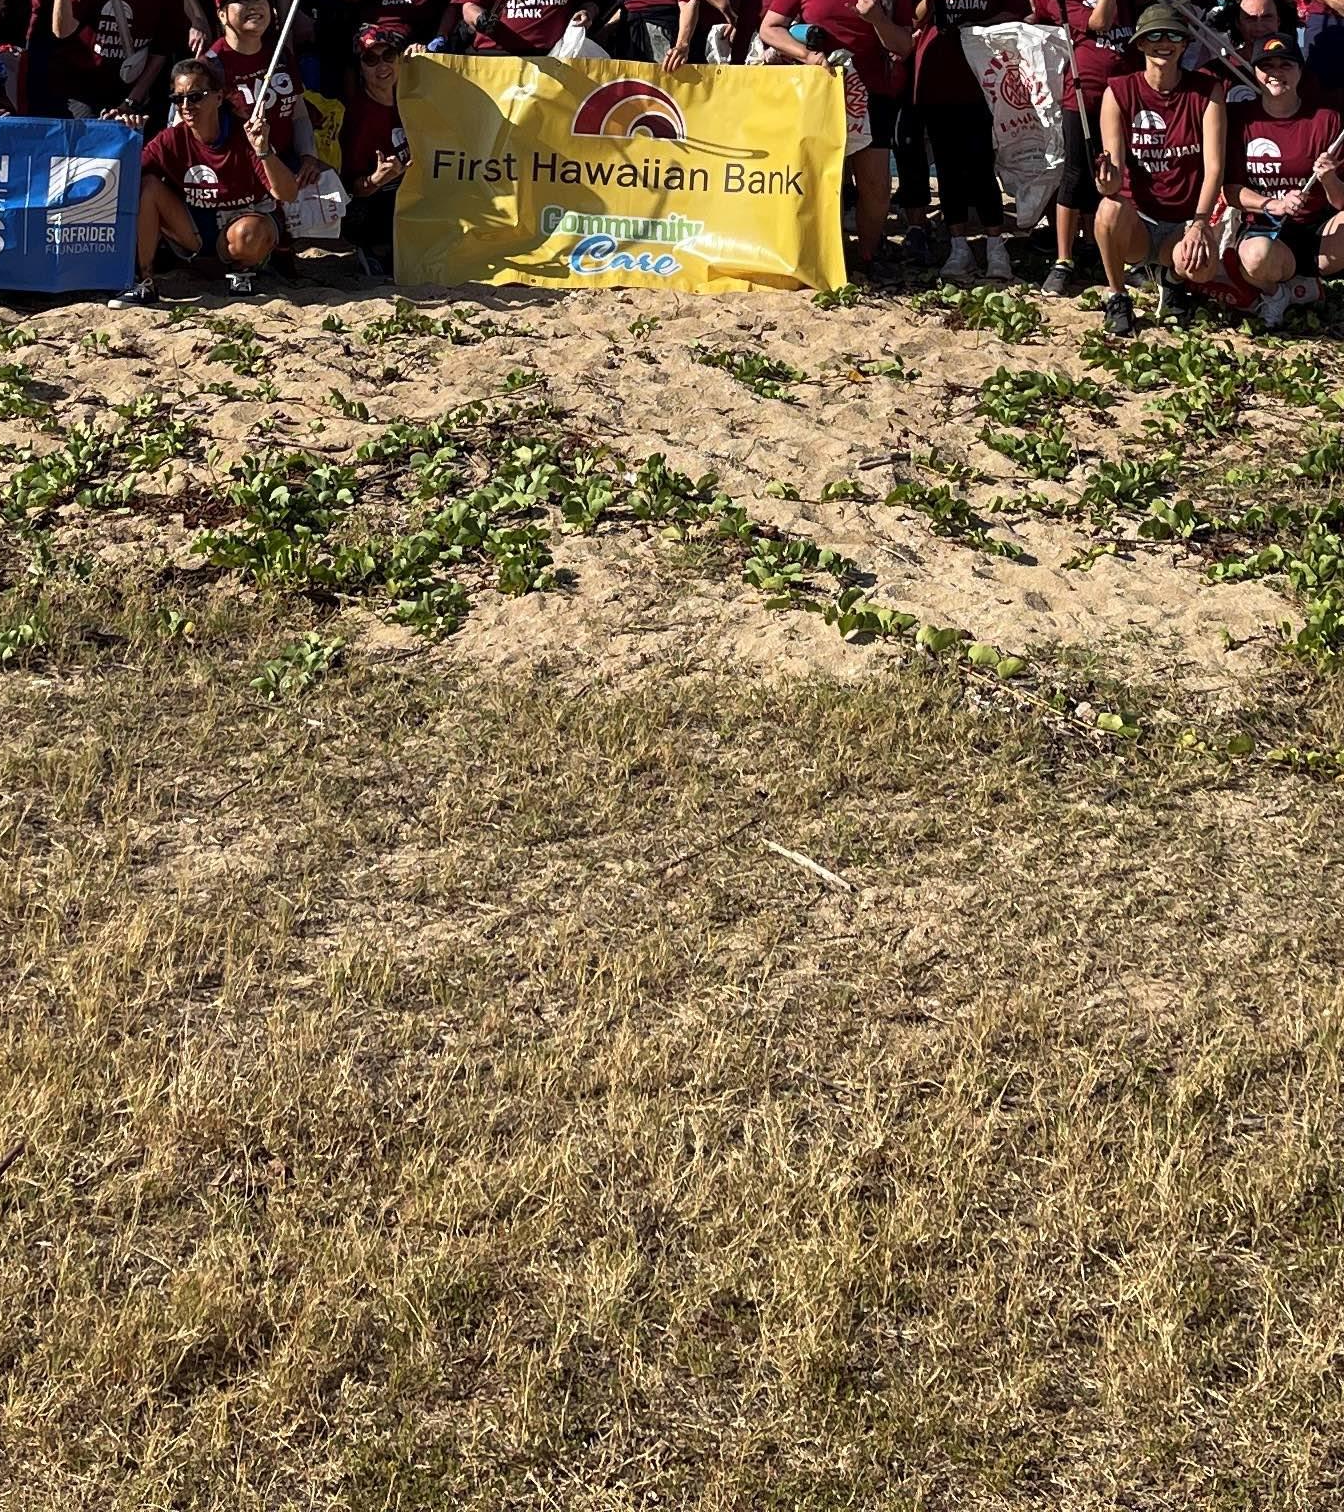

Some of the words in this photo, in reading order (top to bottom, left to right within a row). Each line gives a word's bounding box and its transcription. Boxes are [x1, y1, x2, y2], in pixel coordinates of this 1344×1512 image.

[507, 7, 543, 19] BANK
[1131, 133, 1166, 145] FIRST
[432, 148, 518, 183] First
[531, 152, 709, 193] Hawaiian
[723, 163, 805, 196] Bank
[1246, 161, 1282, 174] FIRST
[183, 187, 219, 199] FIRST
[542, 206, 703, 244] Community
[45, 226, 116, 243] SURFRIDER
[569, 234, 682, 276] Care
